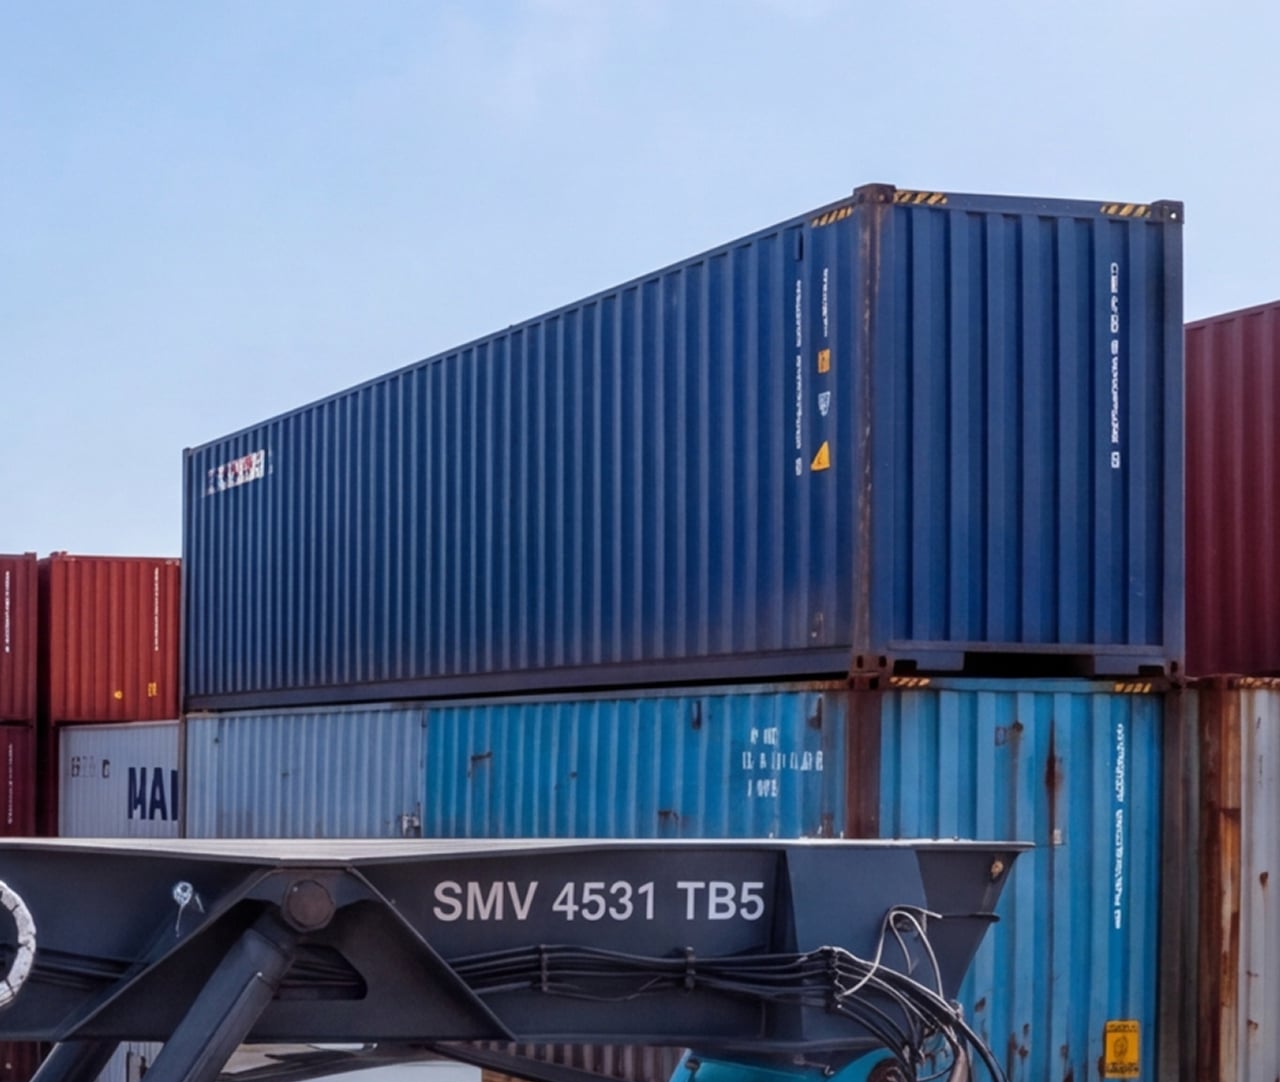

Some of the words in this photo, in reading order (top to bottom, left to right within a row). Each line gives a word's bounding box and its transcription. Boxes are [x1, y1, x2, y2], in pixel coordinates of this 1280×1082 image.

[433, 880, 538, 921] SMV
[552, 880, 655, 921] 4531
[676, 880, 765, 921] TB5
